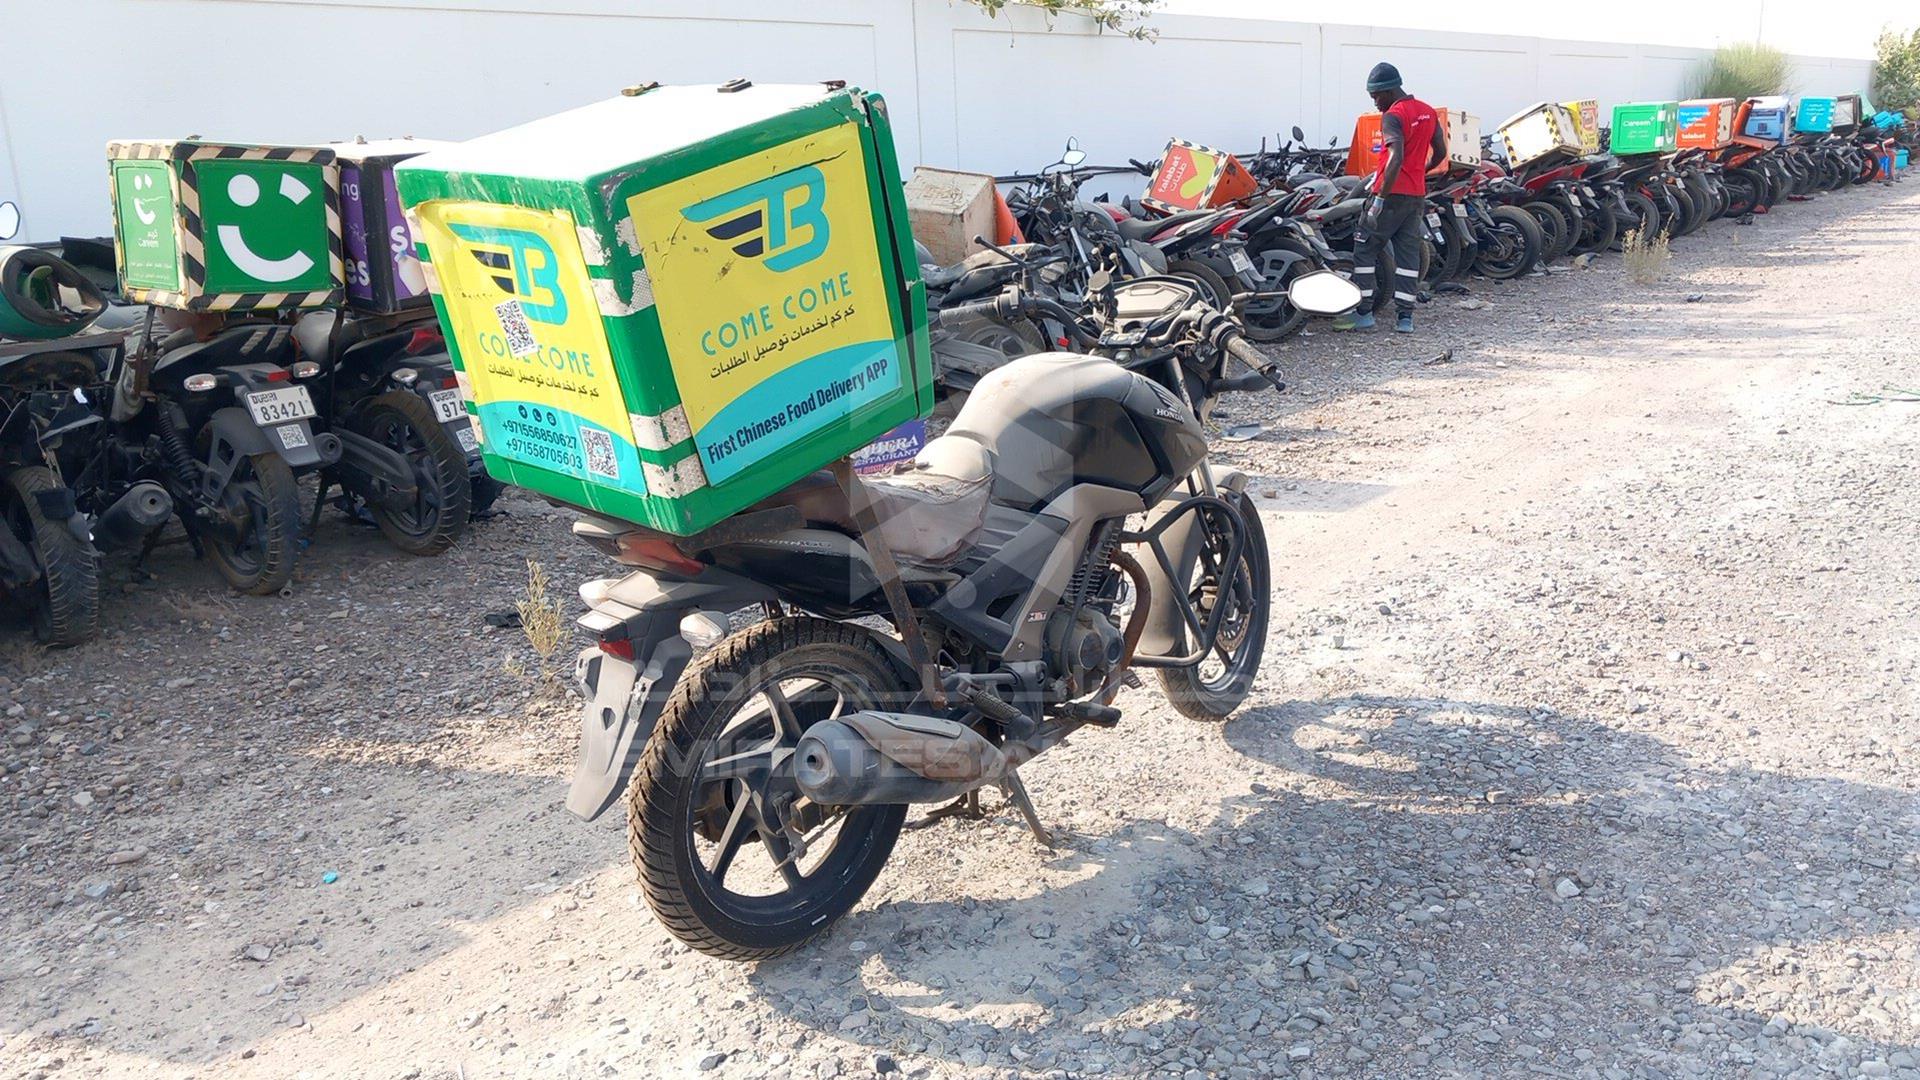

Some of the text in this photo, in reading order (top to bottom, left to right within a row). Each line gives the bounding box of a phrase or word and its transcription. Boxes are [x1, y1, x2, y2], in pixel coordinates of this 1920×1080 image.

[1158, 156, 1182, 193] talabat
[701, 271, 852, 356] COME COME
[710, 304, 856, 379] كم كم لخدمات توصيل الطلبات
[536, 344, 595, 378] COME
[260, 400, 307, 422] 83421
[707, 358, 889, 465] First Chinese Food Delivery APP
[1155, 408, 1185, 423] HONDA
[502, 419, 577, 450] +971556850627
[506, 437, 583, 470] +971558705603
